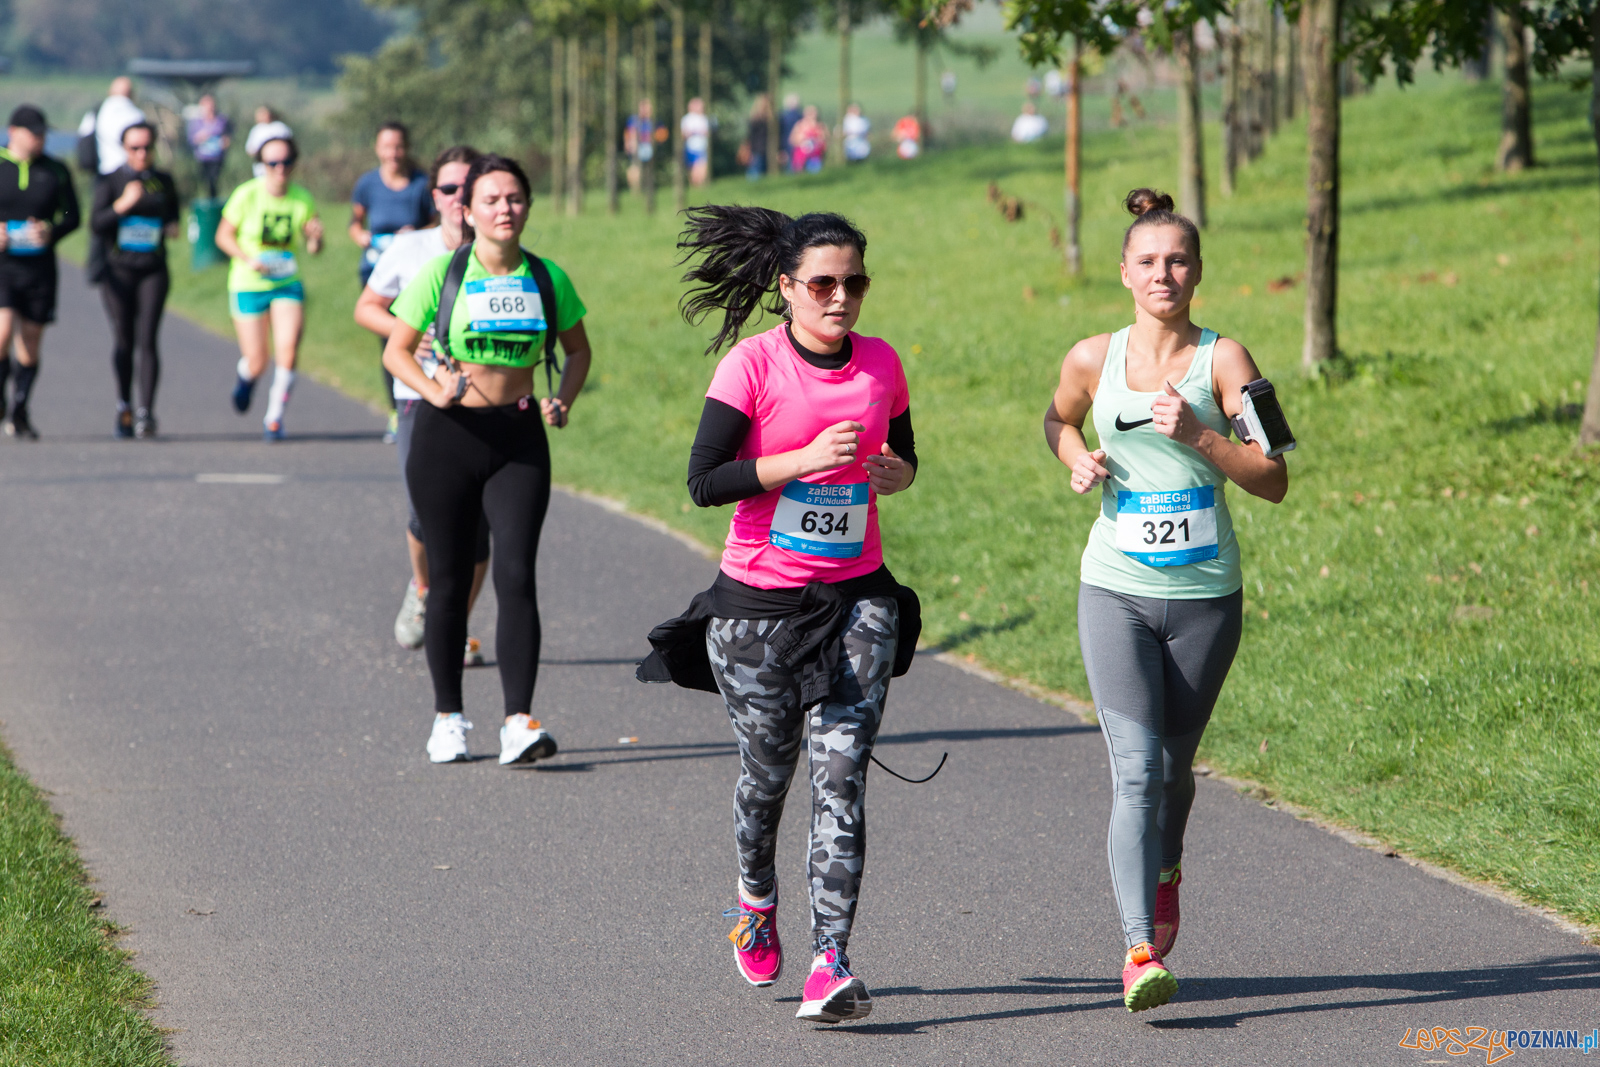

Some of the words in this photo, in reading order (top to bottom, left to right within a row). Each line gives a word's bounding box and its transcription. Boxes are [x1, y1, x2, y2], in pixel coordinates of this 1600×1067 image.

[489, 296, 525, 313] 668
[807, 486, 853, 498] zaBIEGaj
[1139, 492, 1191, 504] zaBIEGaj
[814, 497, 852, 505] FUNdusze
[1147, 504, 1191, 513] FUNdusze
[801, 510, 849, 536] 634
[1142, 517, 1190, 545] 321
